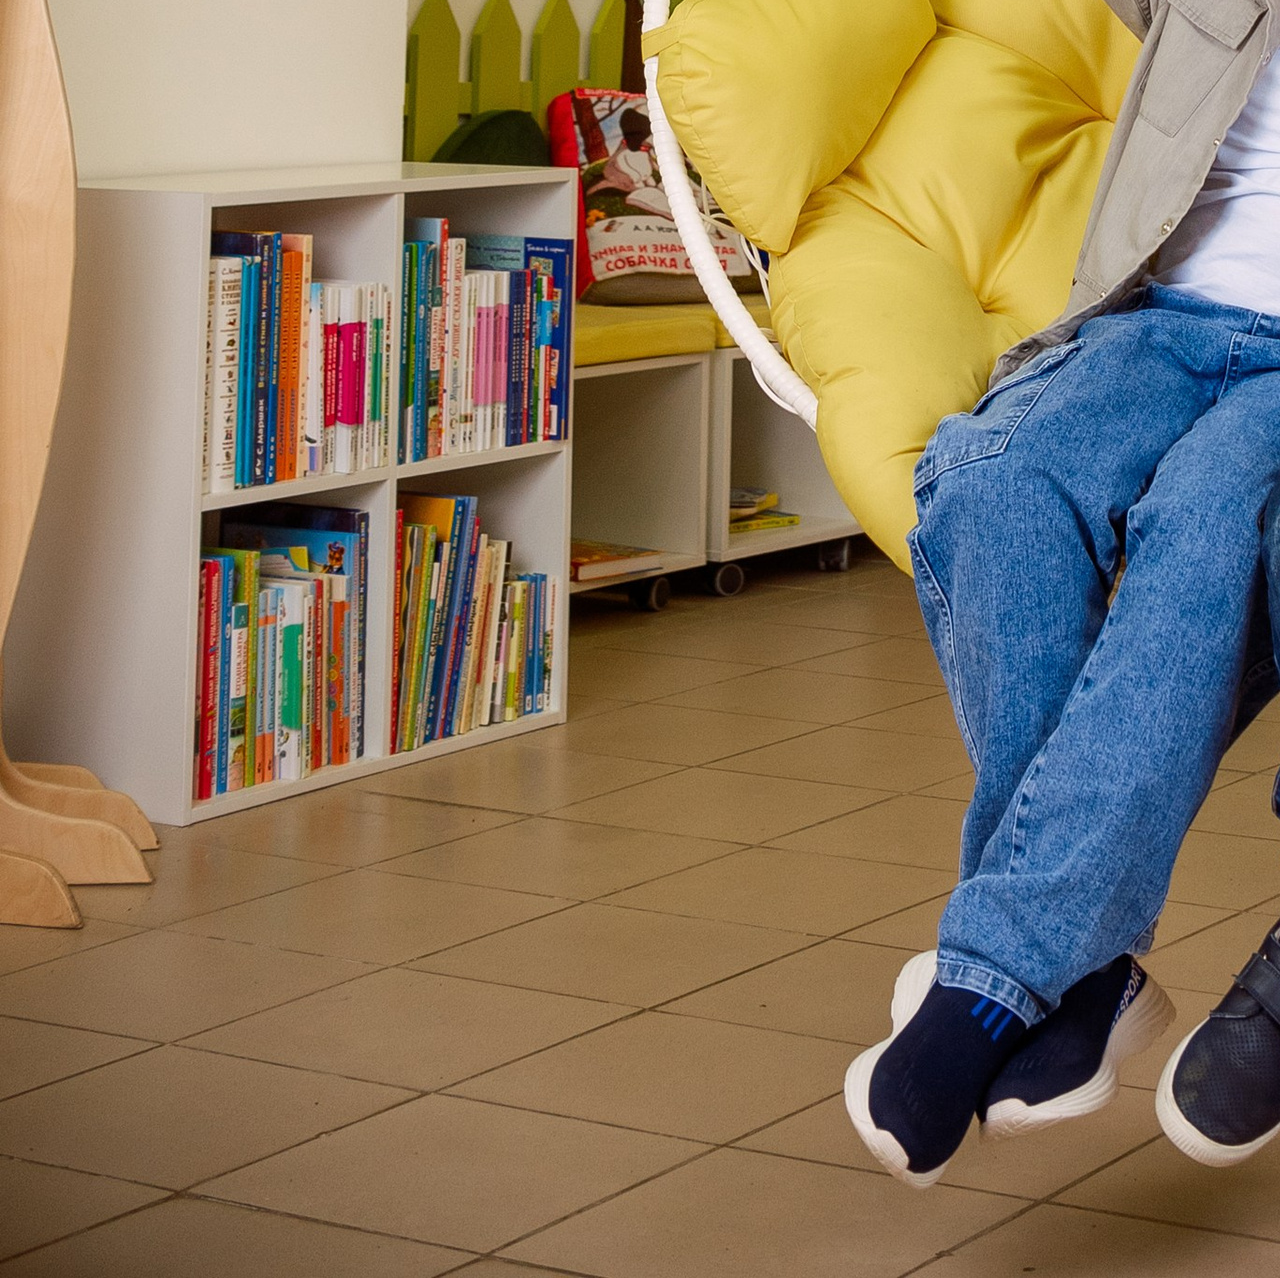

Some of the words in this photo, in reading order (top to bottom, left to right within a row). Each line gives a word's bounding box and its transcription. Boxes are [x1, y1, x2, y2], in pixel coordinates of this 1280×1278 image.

[591, 245, 634, 262] УМНАЯ
[638, 245, 647, 253] И
[652, 244, 737, 255] ЗНАМТАЯ
[605, 255, 678, 272] СОБАЧКА
[256, 399, 266, 444] Маршак
